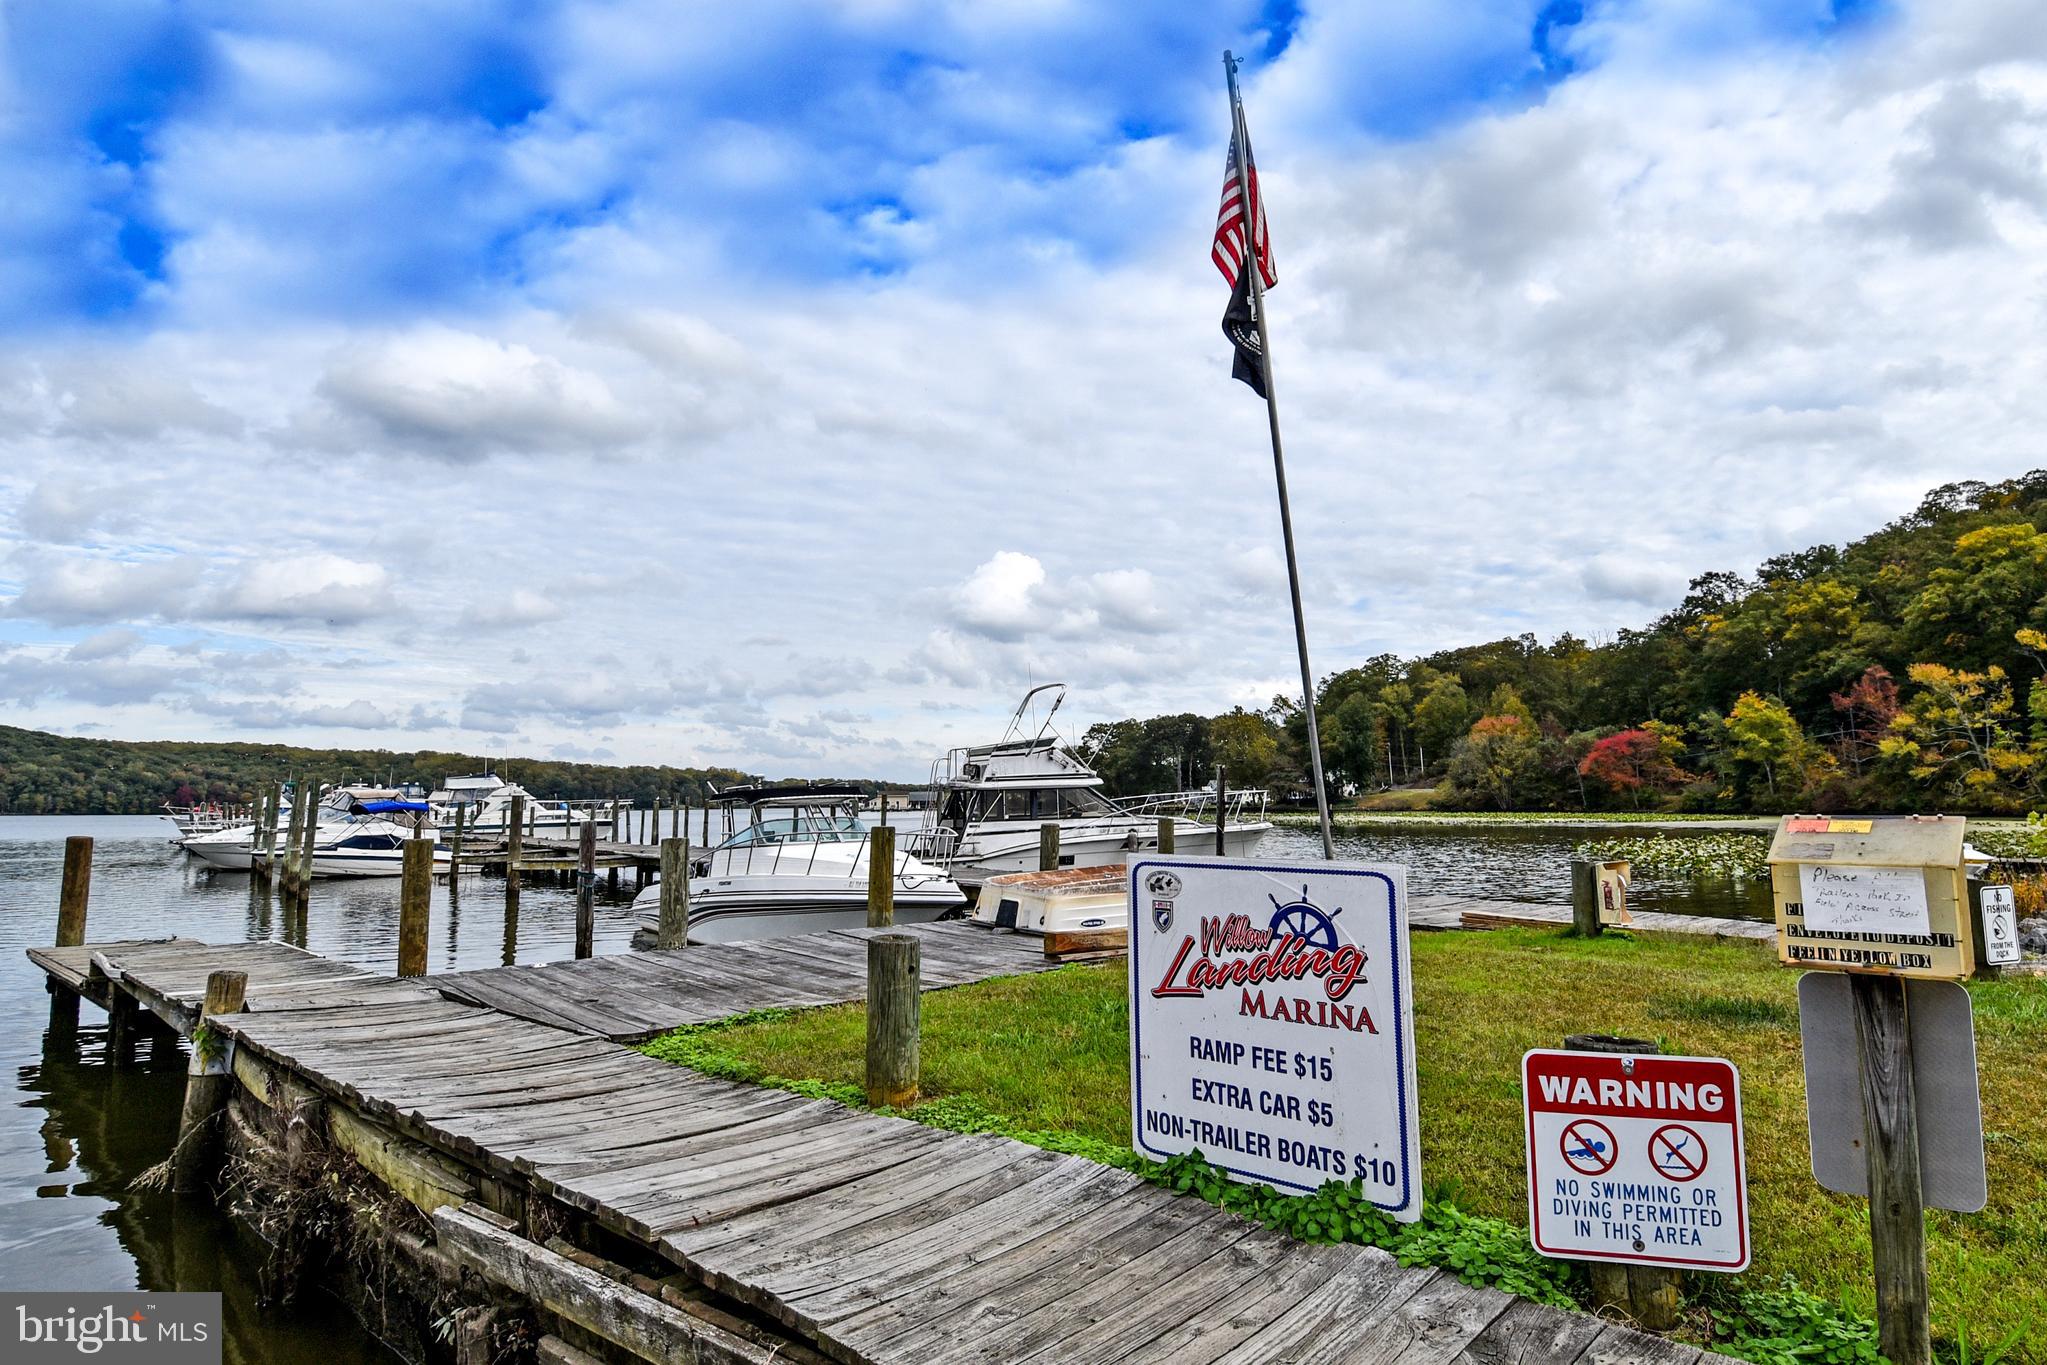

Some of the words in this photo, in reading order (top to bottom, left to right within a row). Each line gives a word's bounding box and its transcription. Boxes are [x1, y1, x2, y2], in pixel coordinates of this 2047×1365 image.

[1812, 867, 1858, 883] Please
[1787, 903, 1804, 916] FI
[1986, 903, 2012, 914] FISHING
[1993, 893, 2003, 903] NO
[1201, 914, 1273, 954] Willow
[1788, 924, 1859, 941] ENVELOPE
[1886, 932, 1954, 947] DEPOSIT
[1991, 942, 2004, 950] FROM
[2004, 941, 2014, 949] THE
[1151, 933, 1369, 1001] Landing
[1789, 945, 1815, 959] FEE
[1819, 947, 1837, 961] IN
[1840, 949, 1897, 965] YELLOW
[1902, 954, 1931, 969] BOX
[1996, 950, 2010, 959] DOCK
[1238, 988, 1380, 1035] MARINA
[1190, 1036, 1246, 1067] RAMP
[1252, 1046, 1288, 1075] FEE
[1294, 1051, 1334, 1083] $15
[1192, 1077, 1254, 1112] EXTRA
[1259, 1090, 1301, 1121] CAR
[1308, 1100, 1335, 1128] $5
[1538, 1075, 1724, 1113] WARNING
[1146, 1109, 1272, 1160] NON-TRAILER
[1278, 1138, 1347, 1176] BOATS
[1354, 1154, 1397, 1187] $10
[1555, 1178, 1580, 1197] NO
[1590, 1181, 1681, 1205] SWIMMING
[1692, 1188, 1717, 1207] OR
[1553, 1198, 1612, 1219] DIVING
[1623, 1203, 1723, 1227] PERMITTED
[1574, 1220, 1591, 1238] IN
[1602, 1221, 1642, 1242] THIS
[1654, 1226, 1703, 1247] AREA
